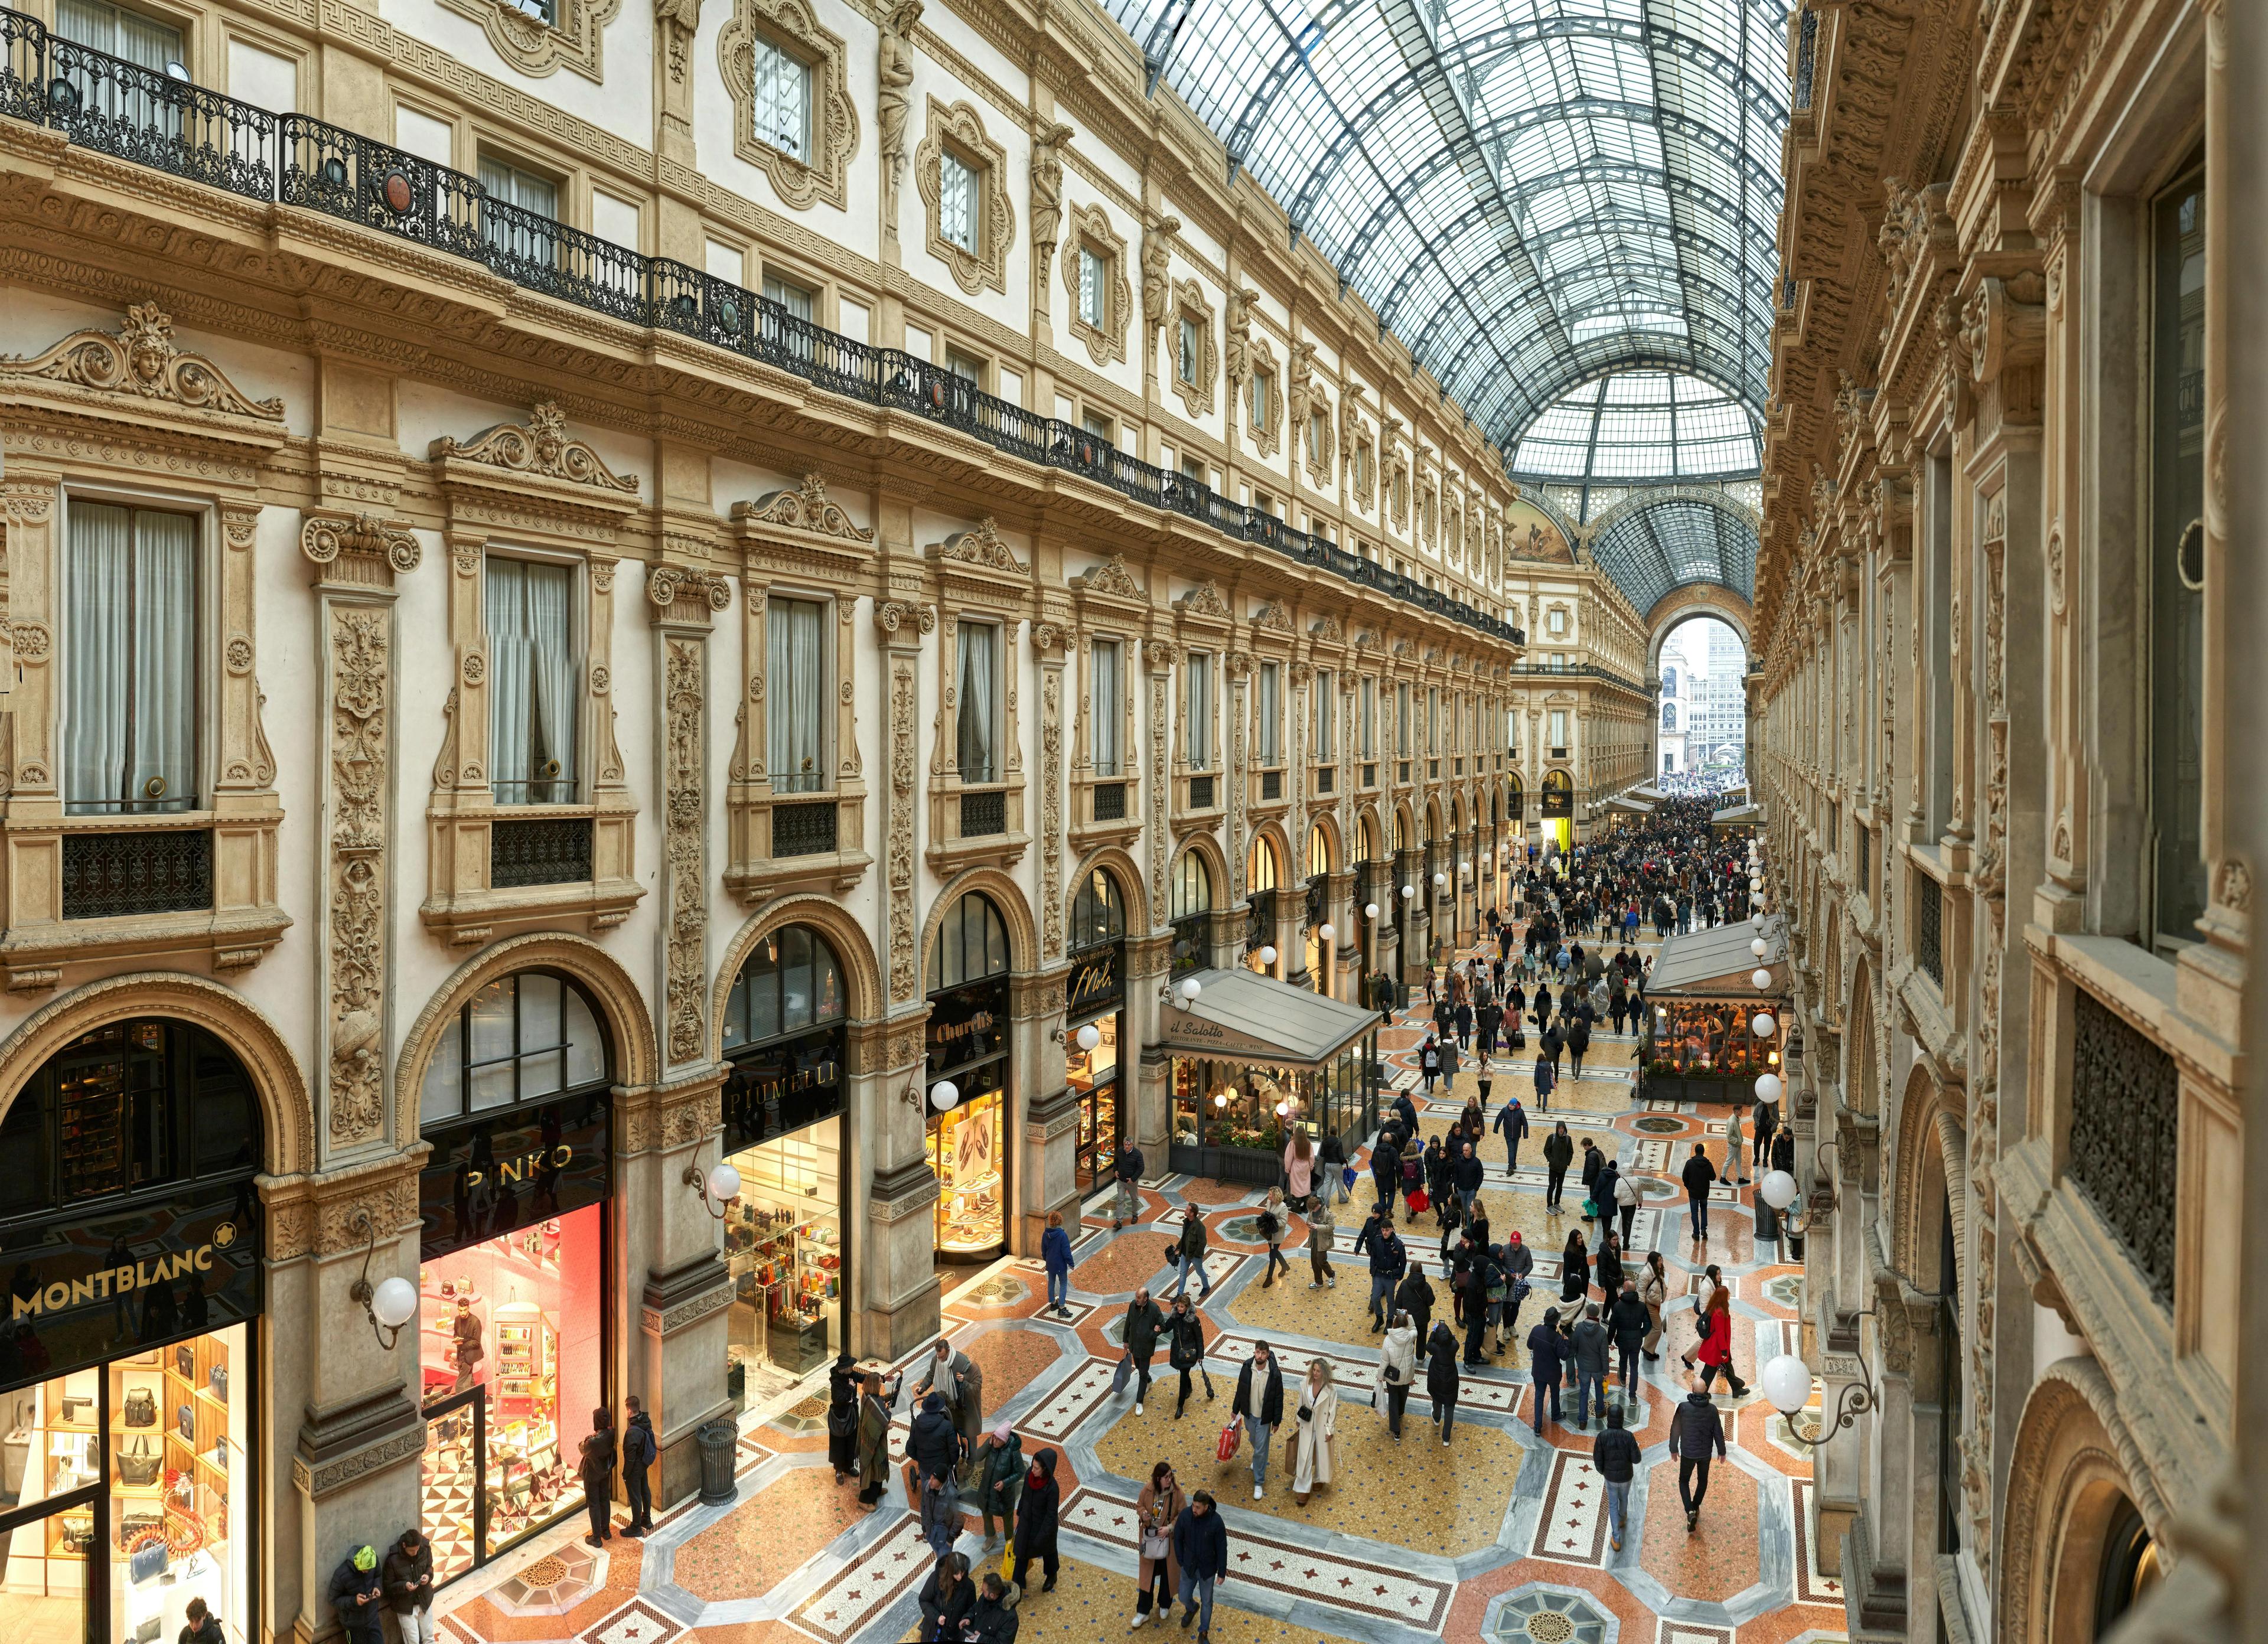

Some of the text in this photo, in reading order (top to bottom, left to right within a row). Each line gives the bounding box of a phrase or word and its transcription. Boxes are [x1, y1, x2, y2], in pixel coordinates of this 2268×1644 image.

[937, 1010, 993, 1043] Church's
[1170, 1020, 1224, 1038] il Salotto
[1171, 1035, 1203, 1043] RISTORANTE
[729, 1062, 835, 1114] PIUMELLI
[463, 1145, 572, 1198] PINKO
[12, 1244, 212, 1320] MONTBLANC
